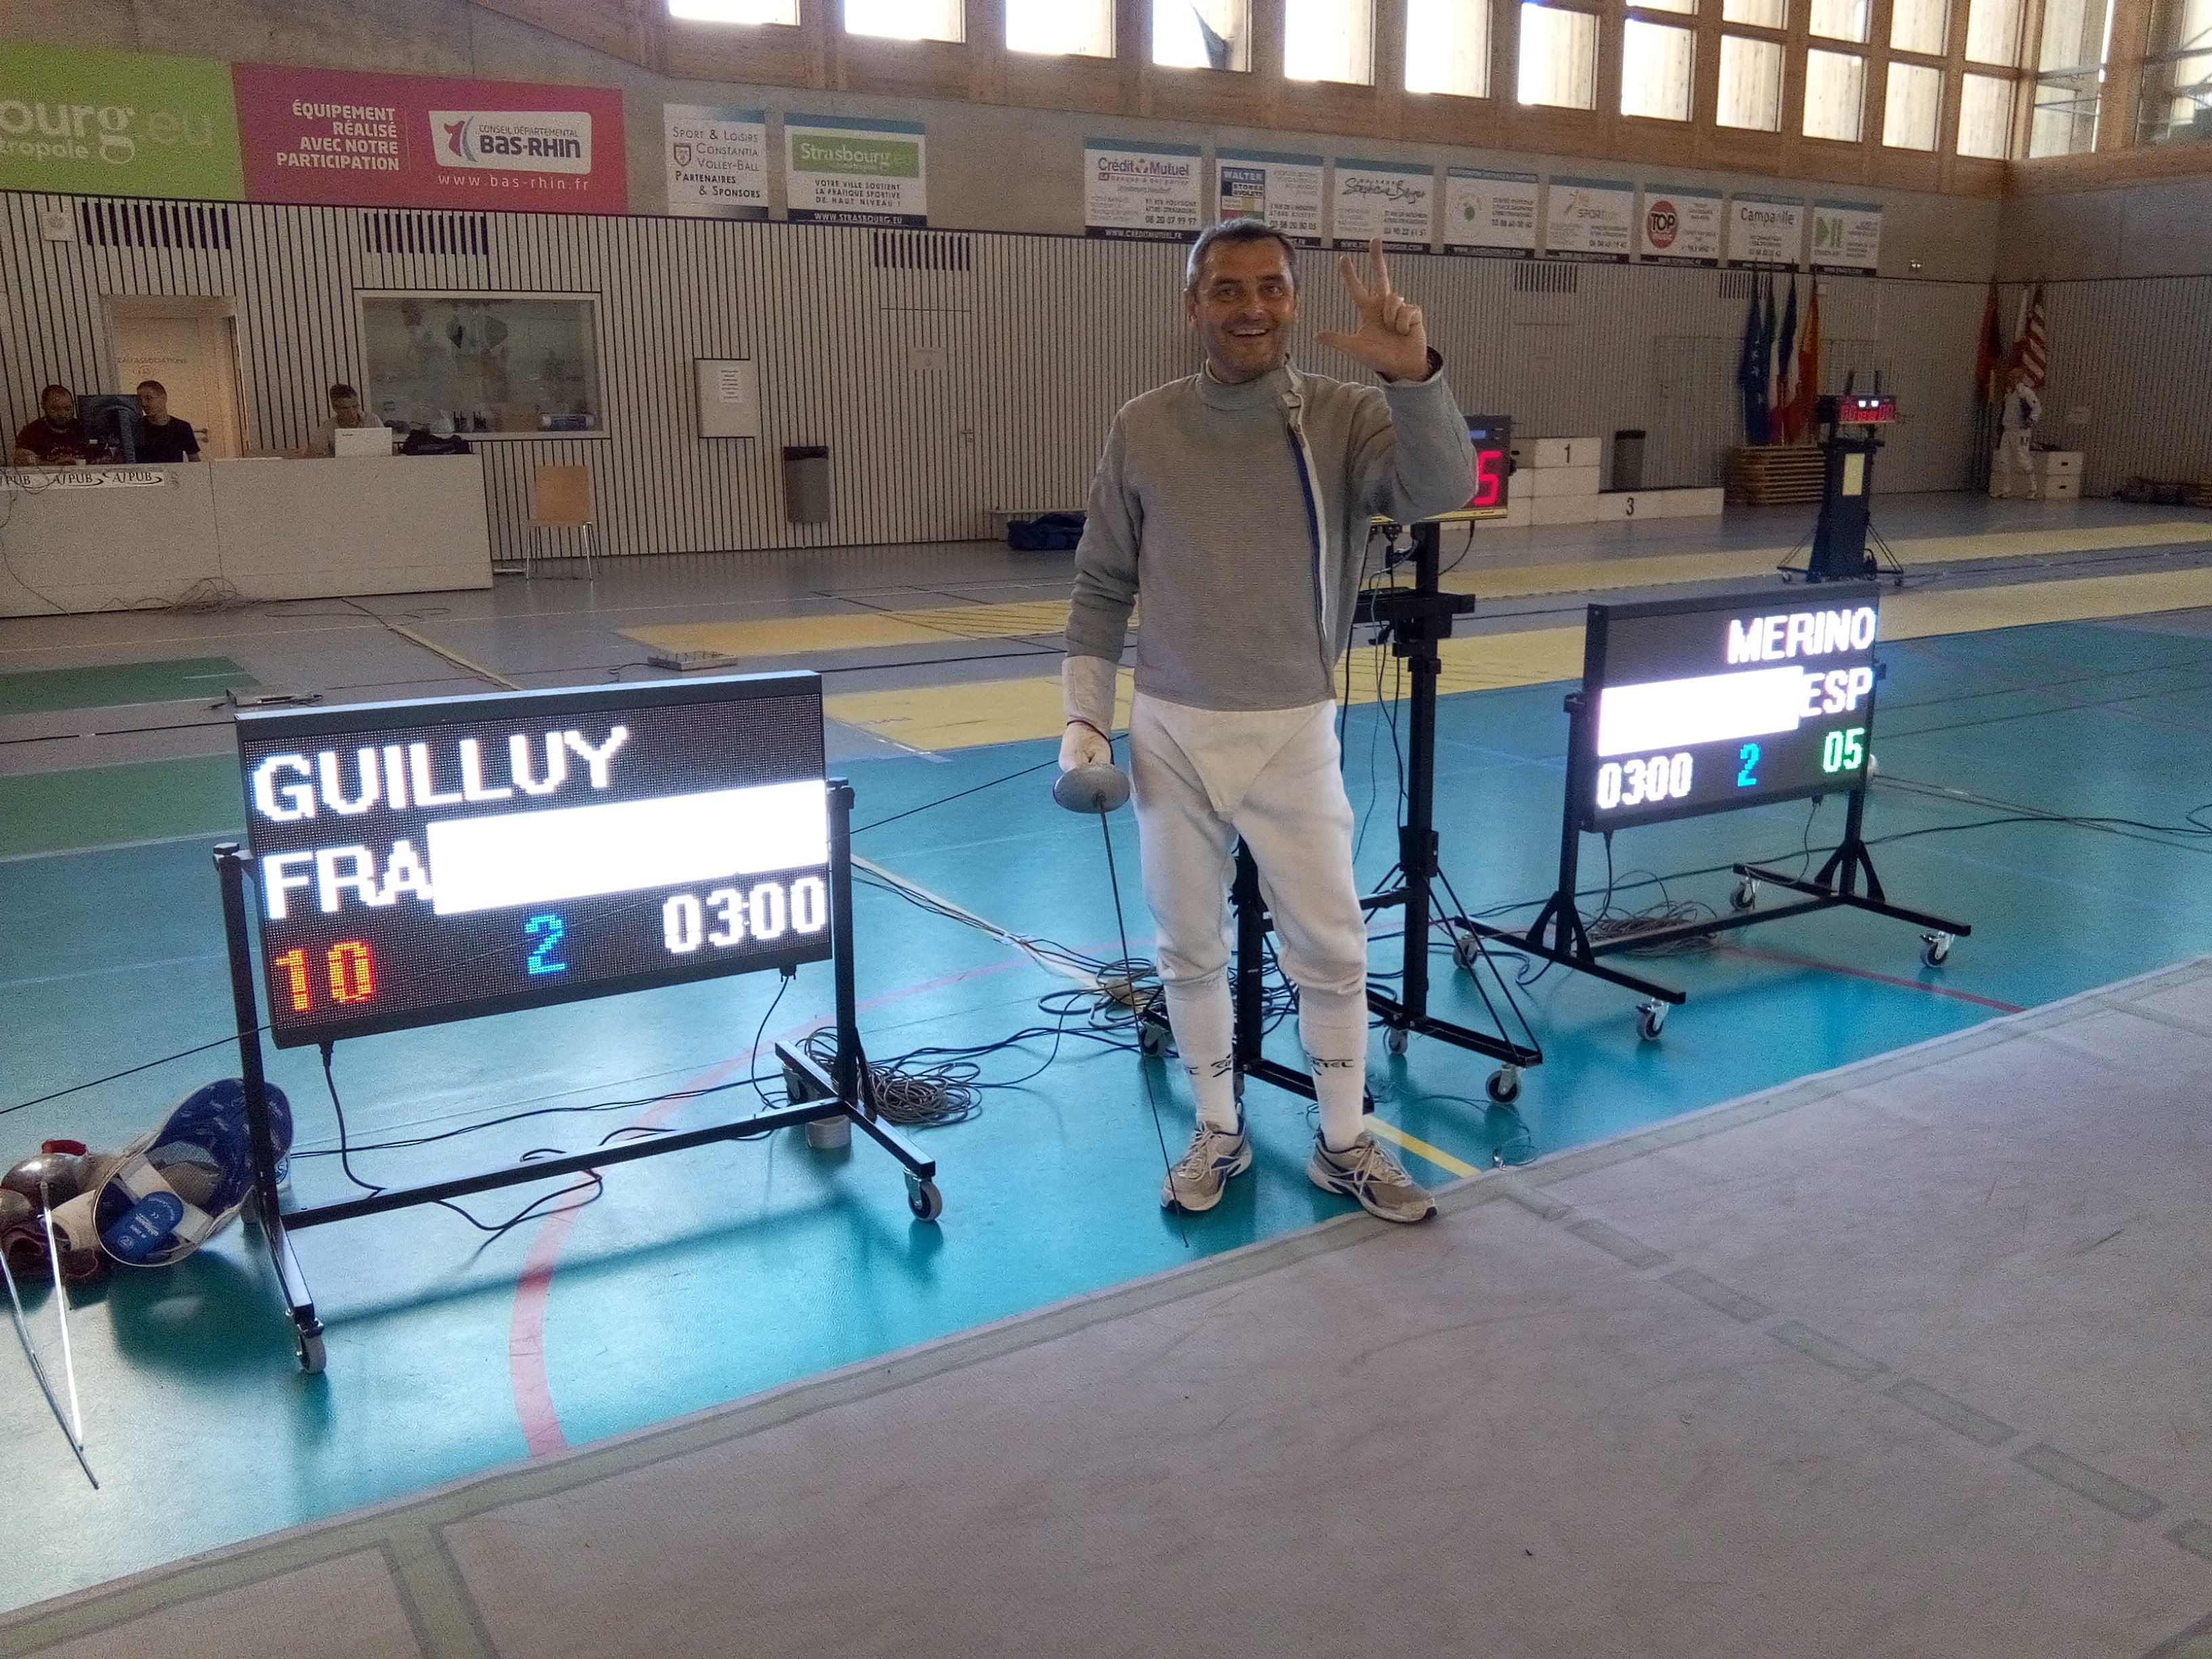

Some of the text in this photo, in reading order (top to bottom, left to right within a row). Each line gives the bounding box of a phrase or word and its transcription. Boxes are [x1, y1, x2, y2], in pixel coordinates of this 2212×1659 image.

[292, 100, 395, 121] ÉQUIPEMENT
[333, 120, 396, 138] RÉALISÉ
[479, 125, 579, 137] CONSEIL DÉPARTEMENTAL
[673, 126, 758, 142] SPORT & LOISIRS
[300, 137, 398, 154] AVEC NOTRE
[696, 143, 758, 157] CONSTANTIA
[276, 152, 398, 170] PARTICIPATION
[697, 157, 759, 171] VOLLEY-BALL
[1099, 157, 1189, 176] Crédit Mutuel
[675, 171, 736, 184] PARTENAIRES
[1223, 171, 1263, 180] WALTER
[699, 185, 760, 198] & SPONSORS
[827, 189, 863, 197] PRATIQUE
[1651, 213, 1675, 230] TOP
[1565, 445, 1570, 463] 1
[1473, 451, 1502, 505] 5
[1626, 497, 1634, 516] 3
[1727, 607, 1877, 663] MERINO
[1800, 667, 1873, 717] ESP
[1737, 743, 1761, 787] 2
[1823, 727, 1865, 773] 05
[254, 726, 628, 821] GUILLUY
[262, 840, 434, 919] FRA
[275, 941, 375, 1012] 10
[523, 914, 567, 976] 2
